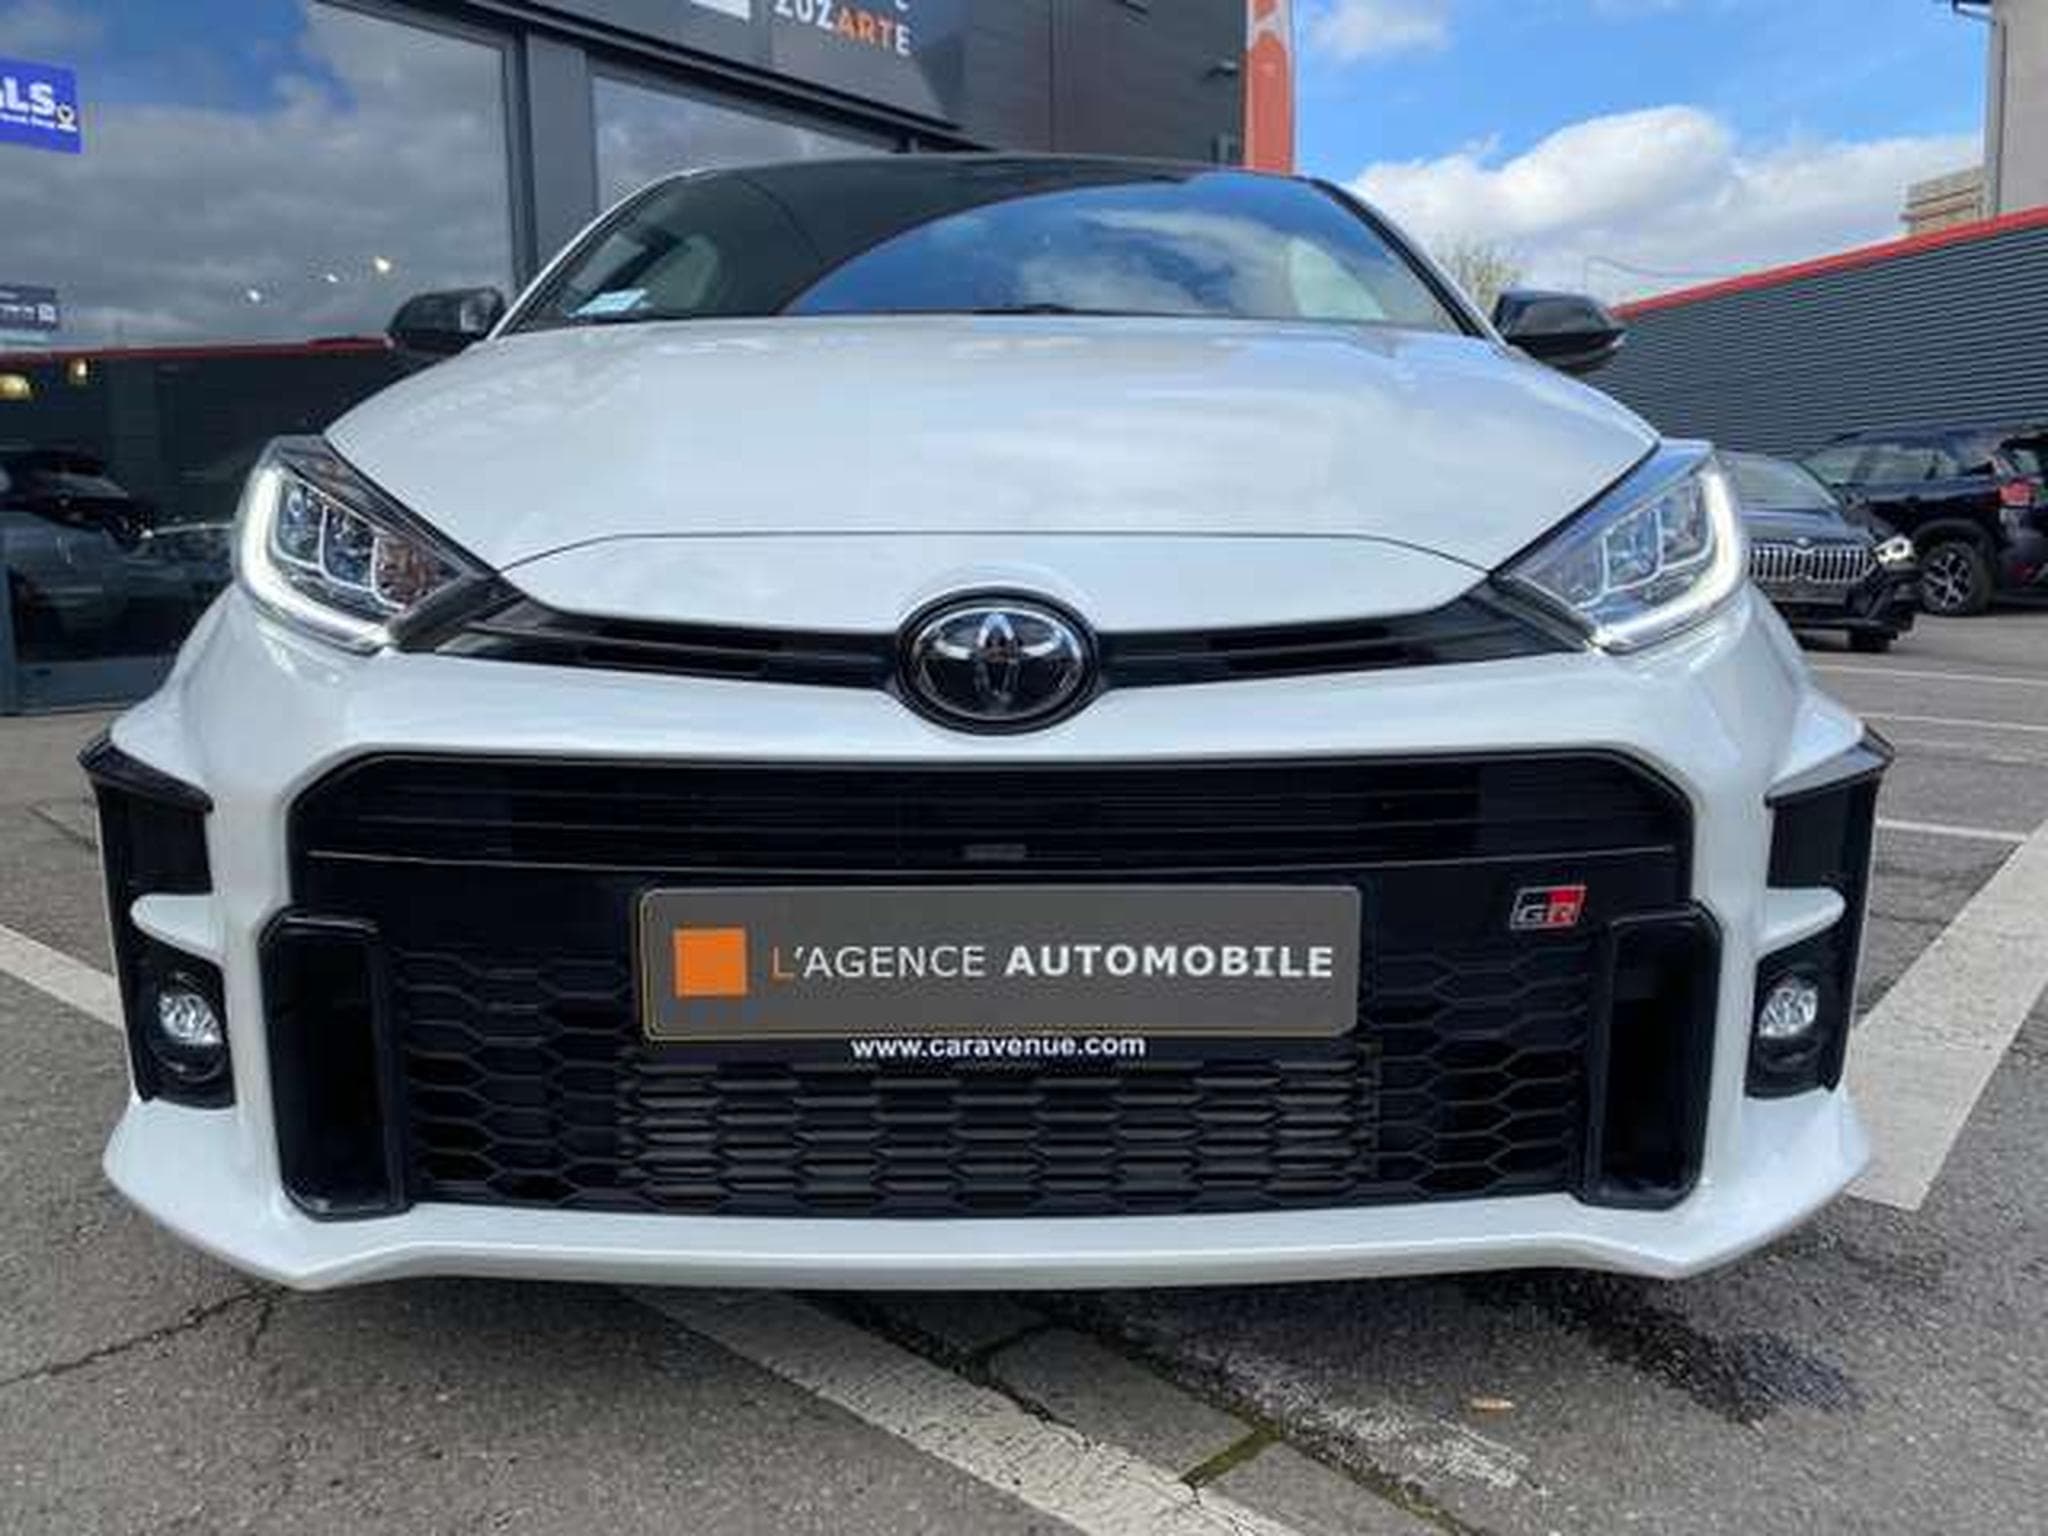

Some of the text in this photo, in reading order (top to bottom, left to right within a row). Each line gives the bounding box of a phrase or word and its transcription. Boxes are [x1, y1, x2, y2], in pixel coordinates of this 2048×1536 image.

[772, 945, 1333, 978] L'AGENCE AUTOMOBILE
[851, 1036, 1146, 1058] www.caravenue.com
